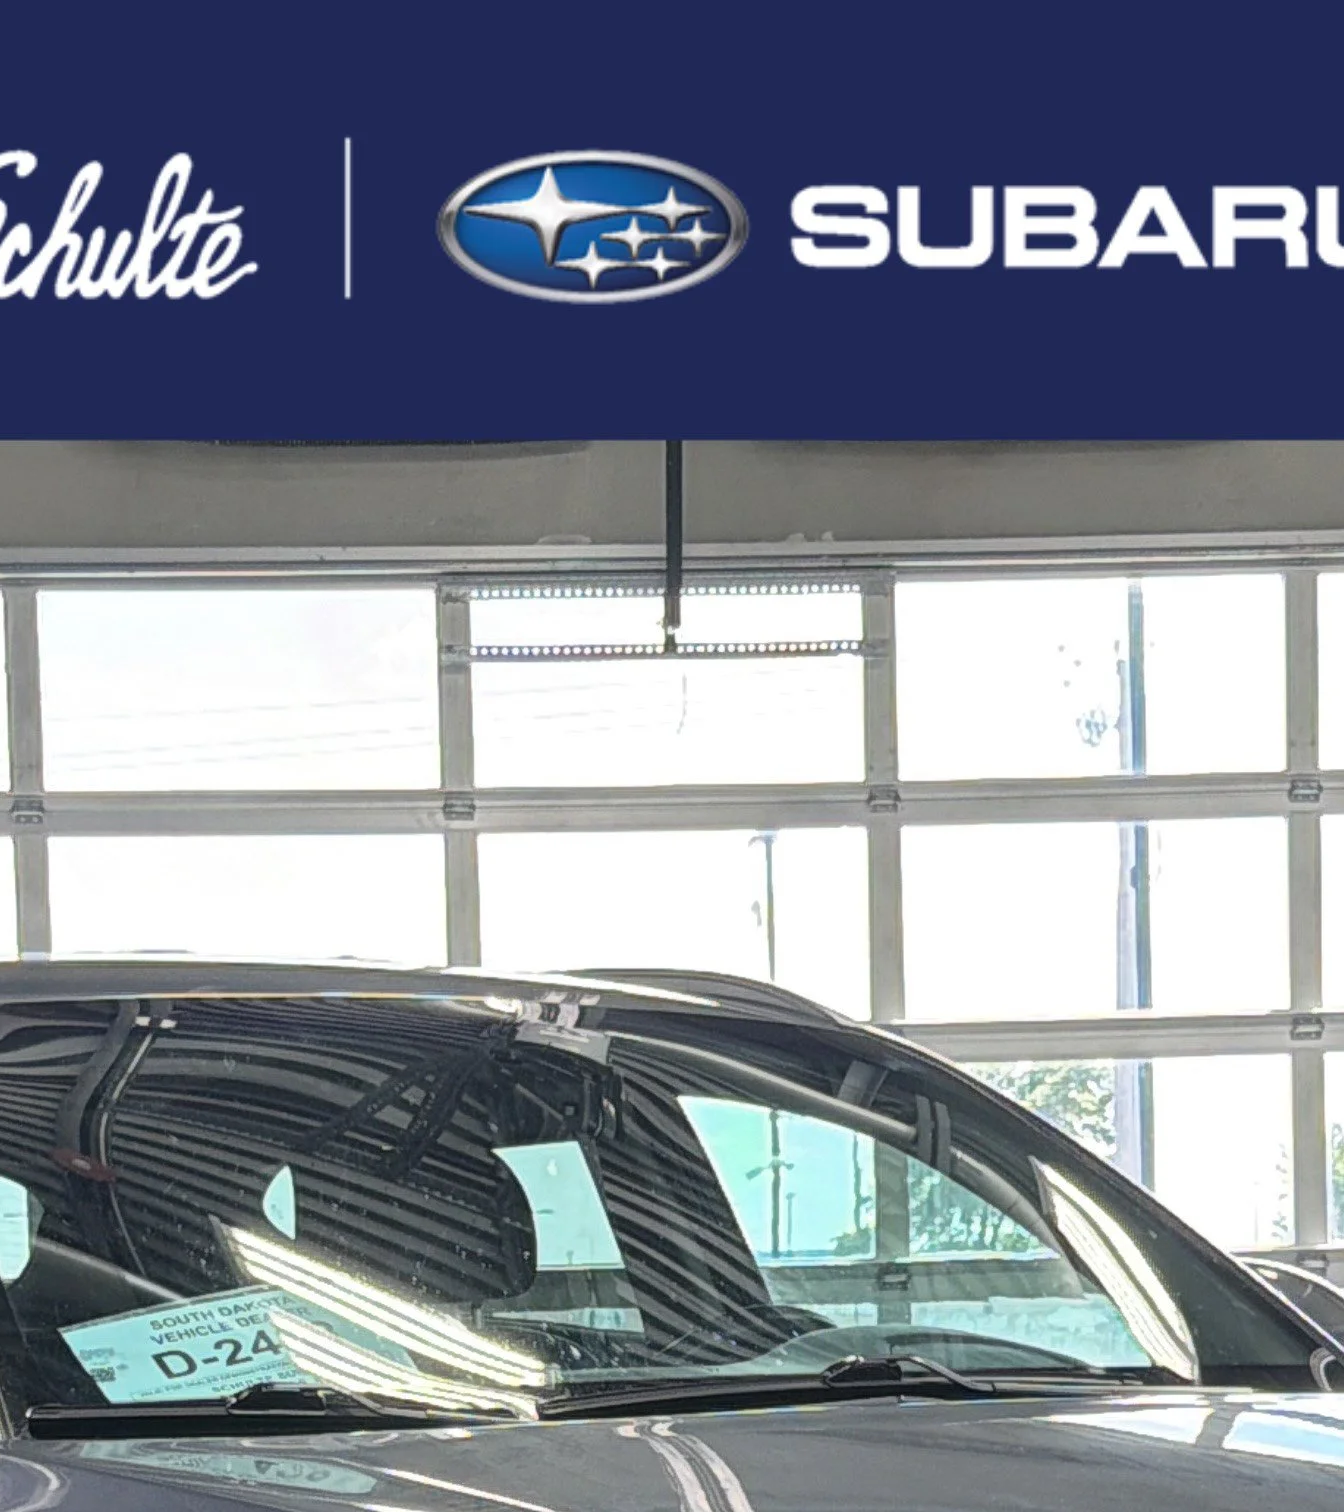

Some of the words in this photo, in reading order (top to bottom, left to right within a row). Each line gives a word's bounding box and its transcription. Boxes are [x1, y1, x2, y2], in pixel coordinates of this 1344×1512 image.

[149, 1309, 214, 1331] SOUTH
[217, 1296, 296, 1317] DAKOTA
[149, 1322, 234, 1345] VEHICLE
